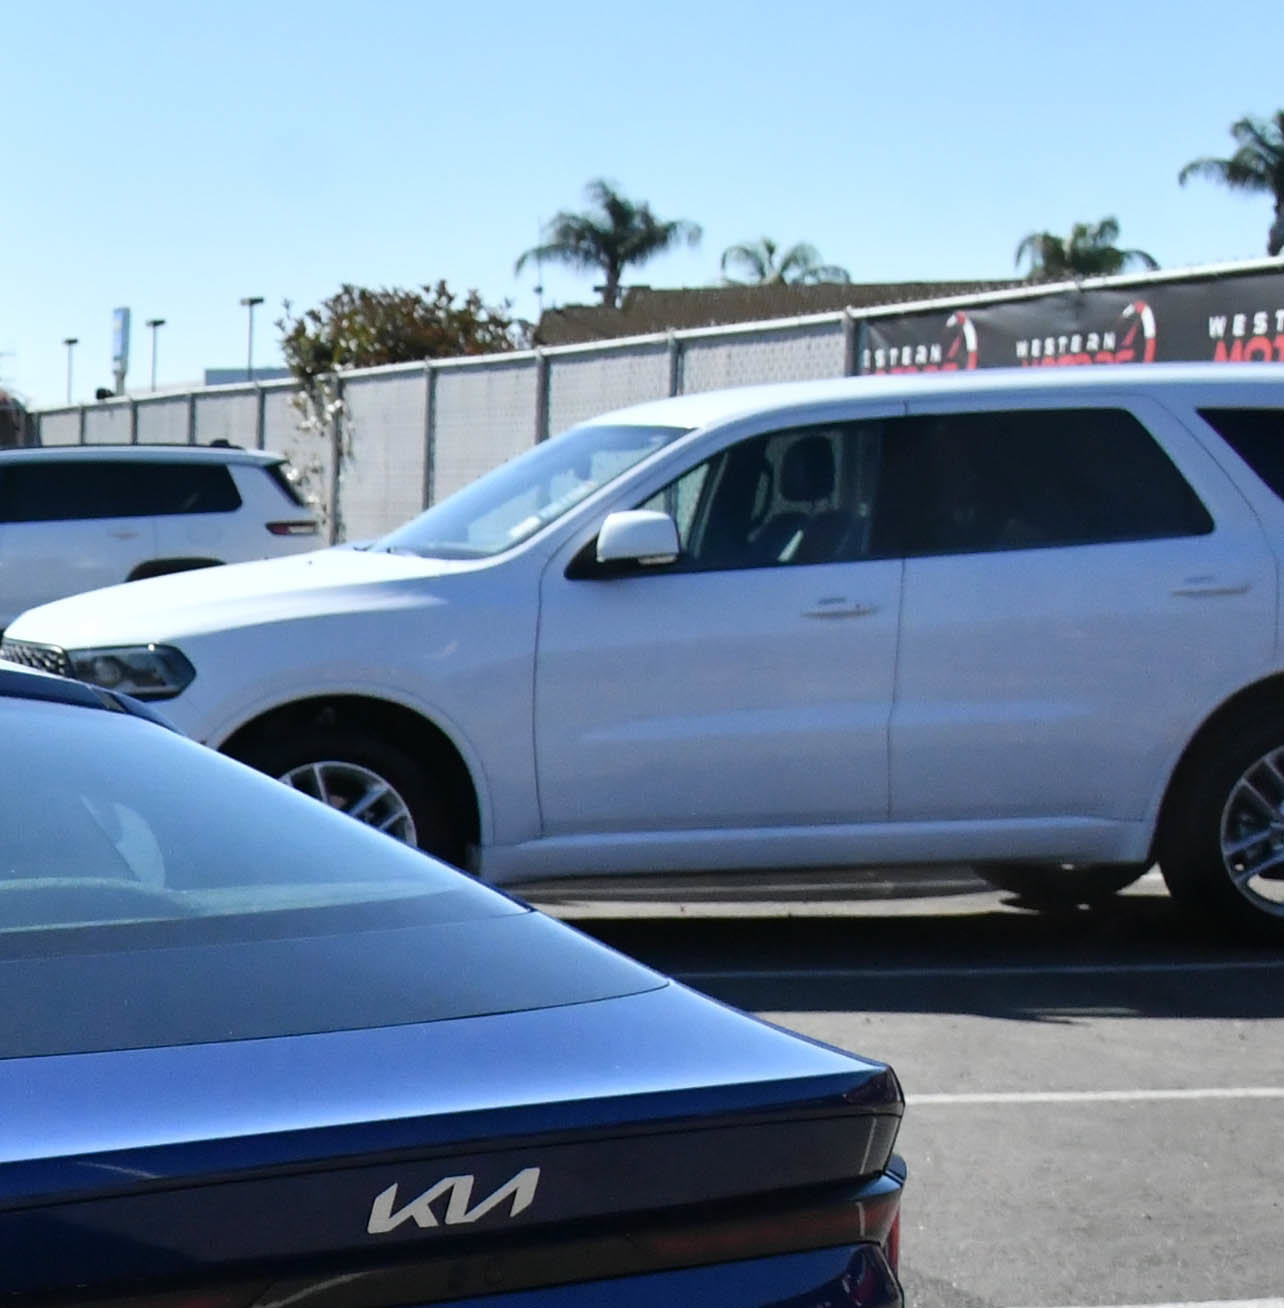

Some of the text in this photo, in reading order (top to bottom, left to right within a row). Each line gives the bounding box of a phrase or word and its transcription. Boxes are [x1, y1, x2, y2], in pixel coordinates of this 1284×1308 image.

[1209, 309, 1284, 338] WEST
[864, 344, 941, 369] ESTERN
[367, 1166, 540, 1234] KIA
